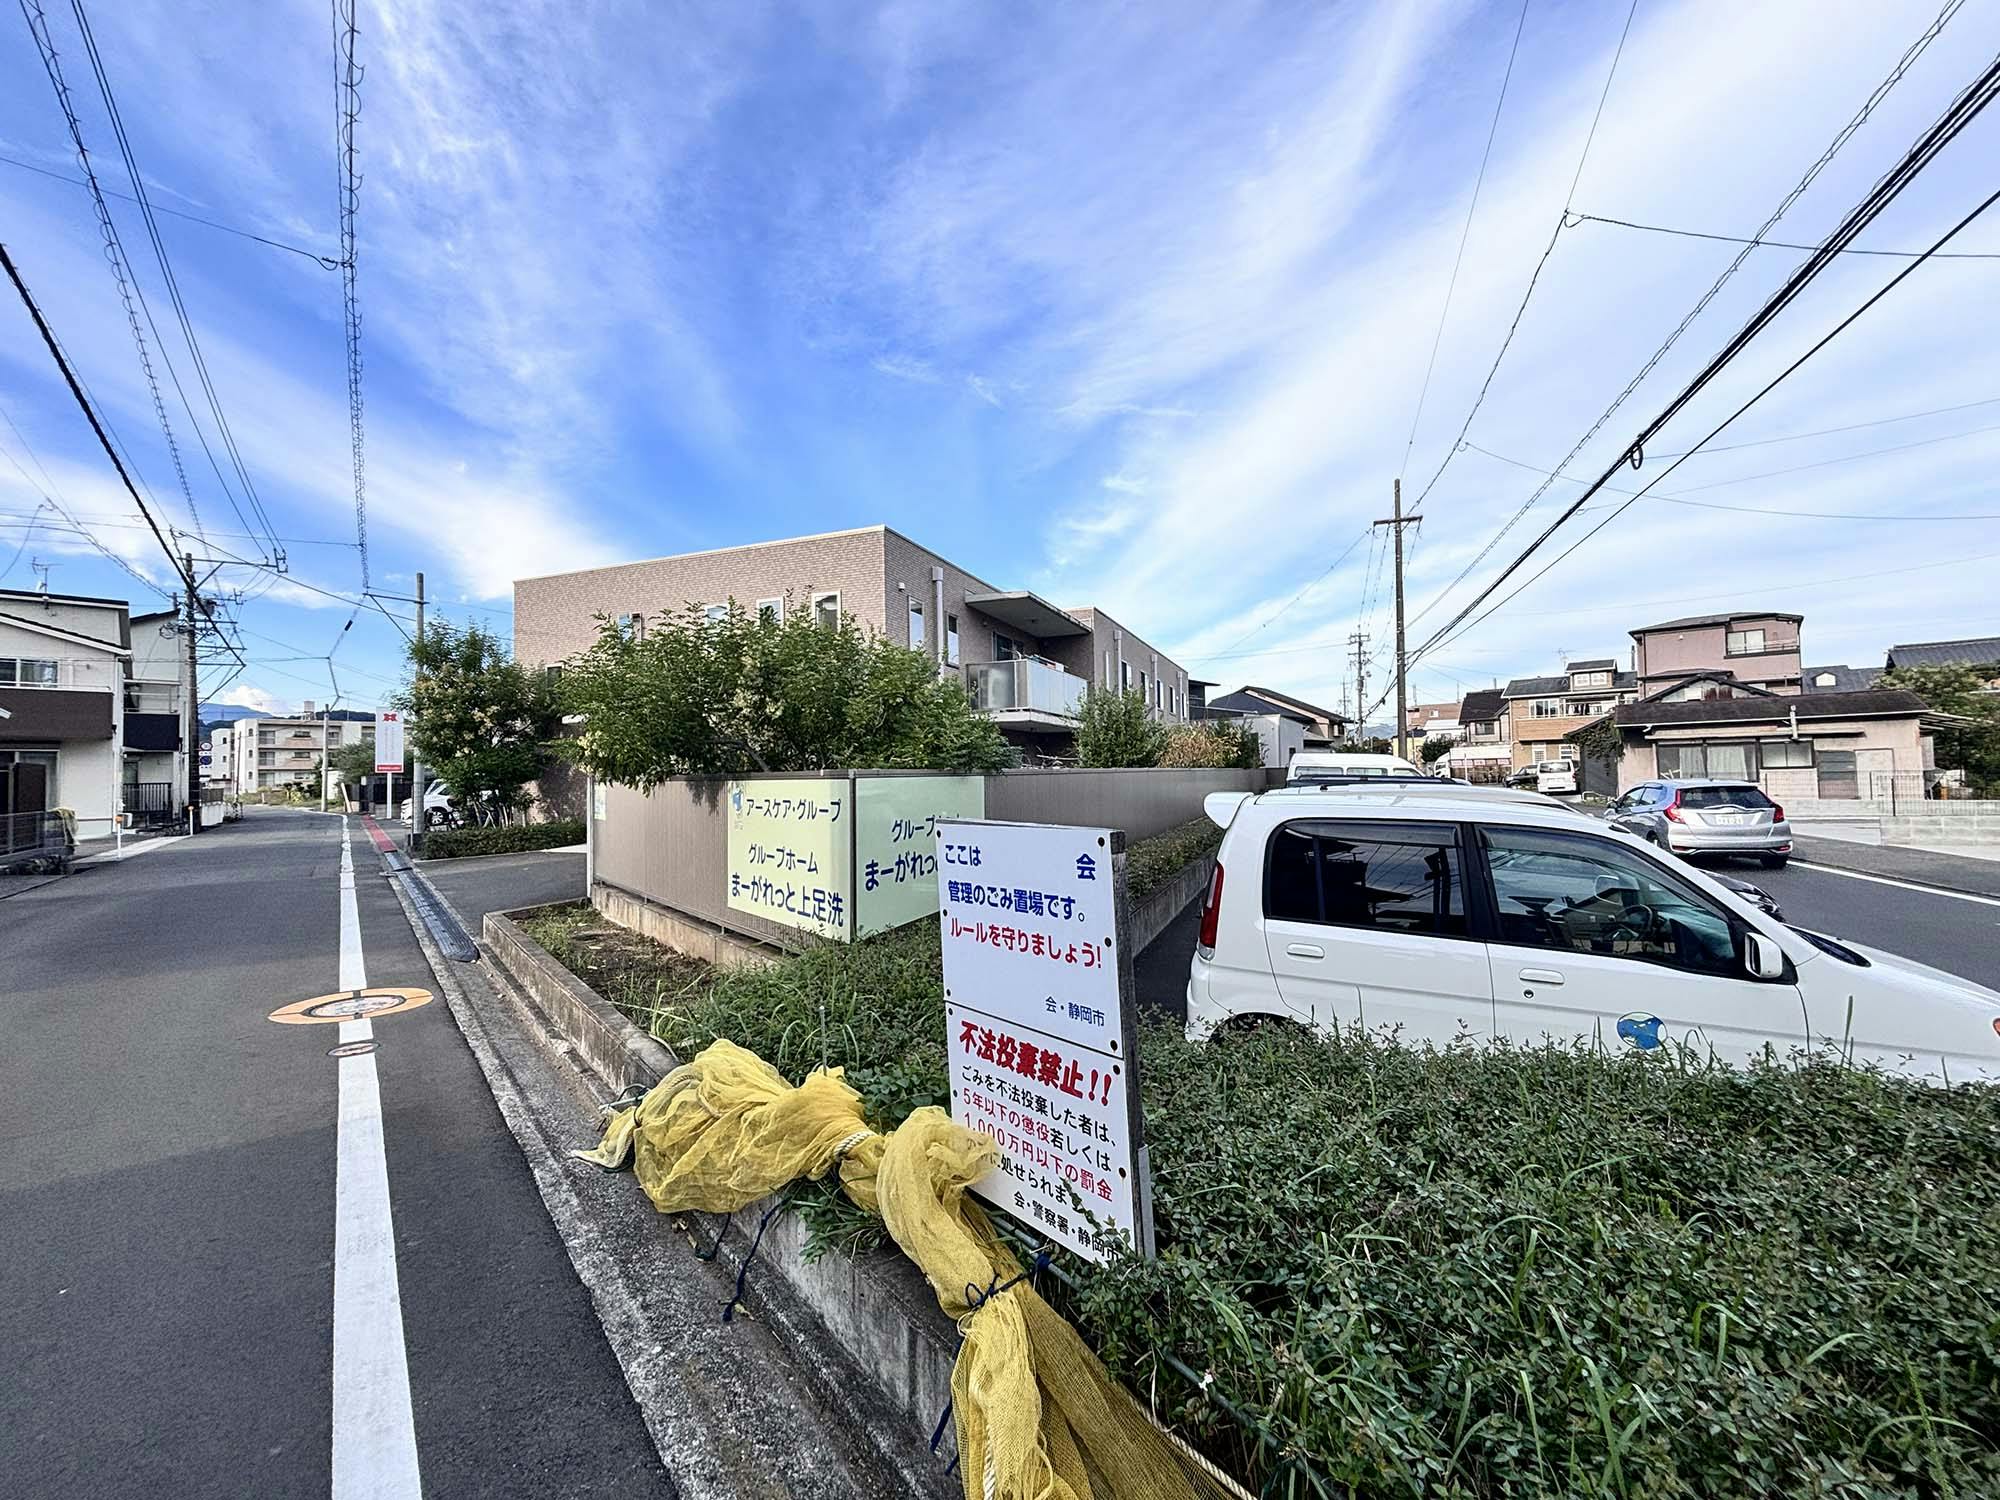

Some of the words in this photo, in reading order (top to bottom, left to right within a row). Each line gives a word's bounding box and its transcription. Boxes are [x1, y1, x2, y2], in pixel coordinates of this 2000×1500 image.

[746, 798, 842, 823] アースケア・グループ
[748, 843, 819, 874] グループホーム
[865, 850, 939, 892] まーがれっ
[945, 844, 982, 867] ここは
[1075, 853, 1096, 881] 会
[731, 872, 844, 928] まーがれっと上足洗
[947, 879, 1086, 922] 管理のごみ置場です。
[950, 917, 1103, 969] ルールを守りましょう!
[1045, 996, 1106, 1028] 会・静岡市
[959, 1020, 1113, 1107] 不法投棄禁止!!
[961, 1065, 1117, 1148] ごみを不法投棄した者は、
[963, 1087, 1112, 1173] 5年以下の懲役若しくは
